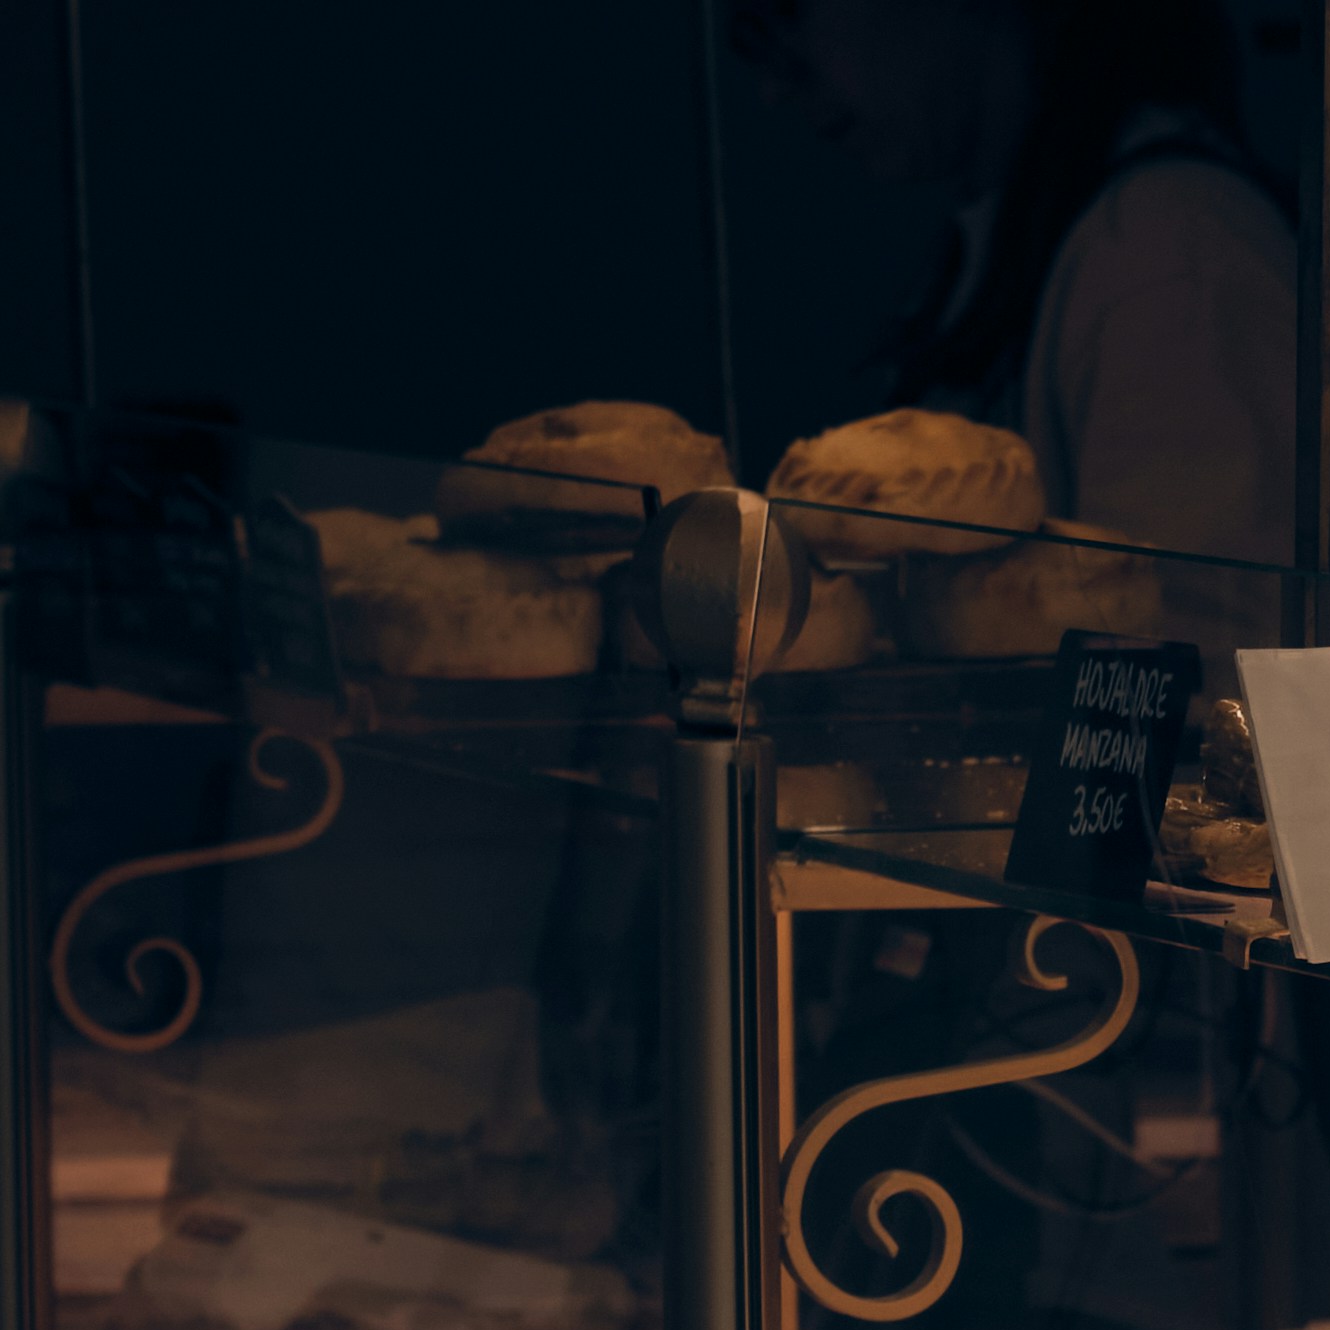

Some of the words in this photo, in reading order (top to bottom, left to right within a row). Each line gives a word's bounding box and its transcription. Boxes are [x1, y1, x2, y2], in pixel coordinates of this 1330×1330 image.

[1072, 657, 1174, 719] HOJALDRE
[1059, 720, 1148, 778] MANZANA
[1069, 784, 1128, 836] 3,50€
